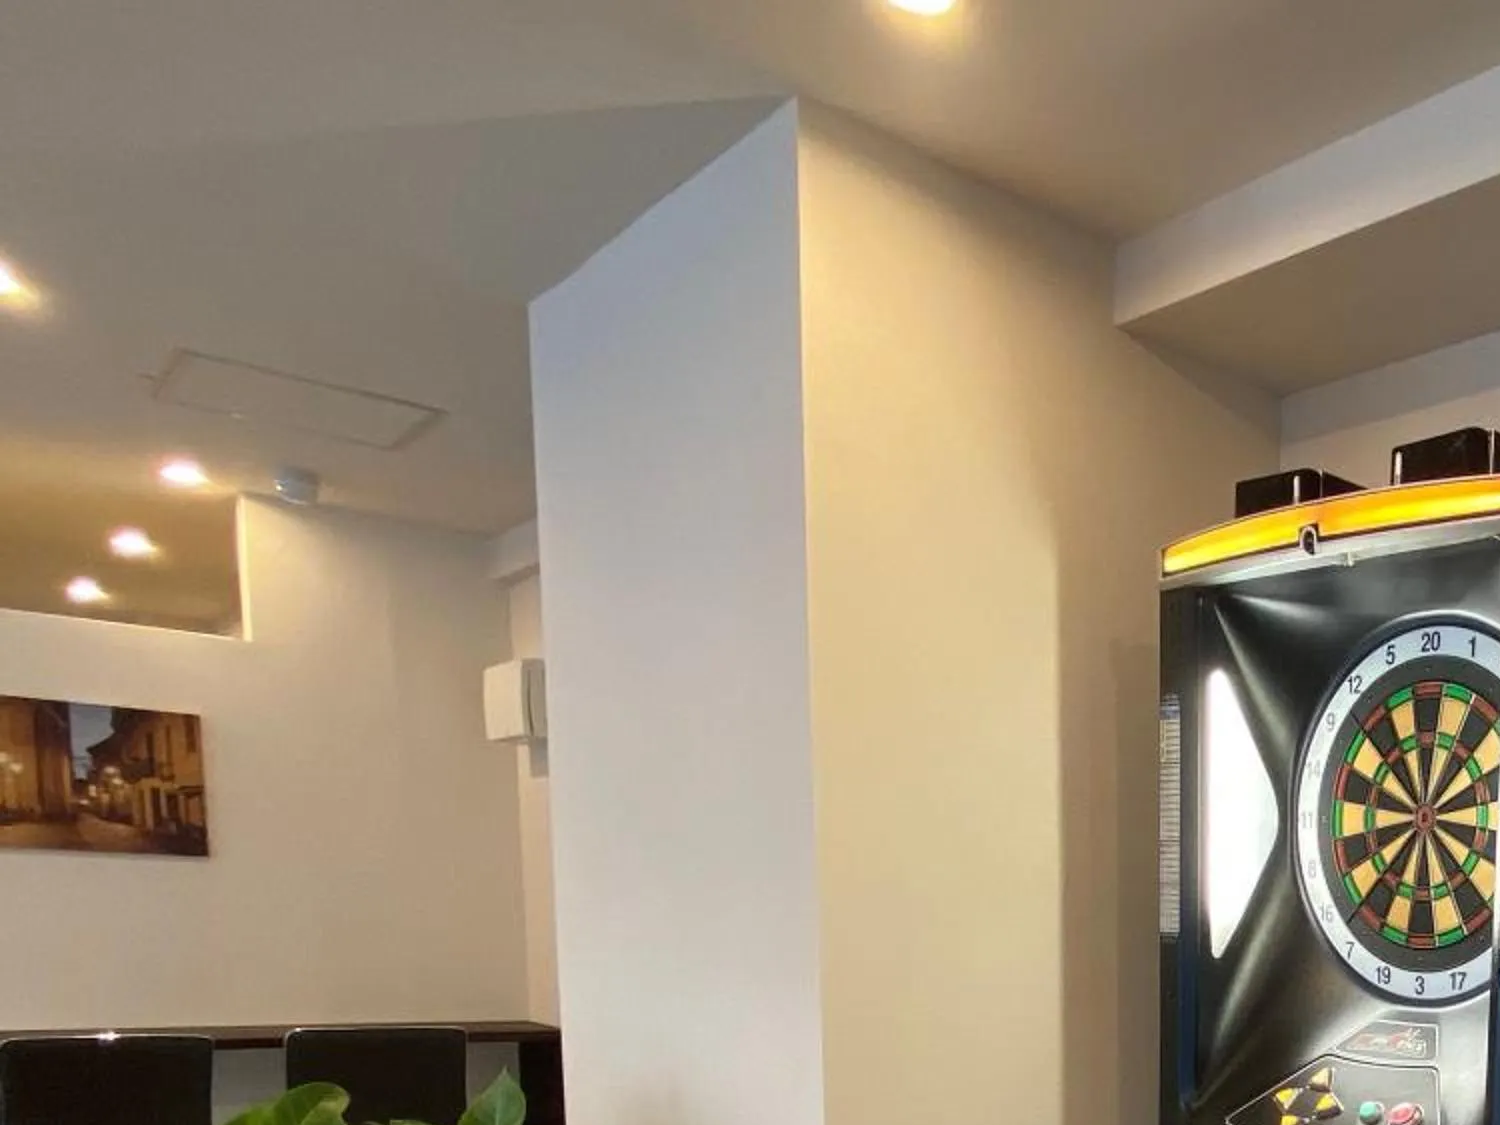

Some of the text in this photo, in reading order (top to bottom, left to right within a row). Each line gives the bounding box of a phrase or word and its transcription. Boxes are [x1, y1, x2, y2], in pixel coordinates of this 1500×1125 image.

[1421, 631, 1441, 653] 20
[1468, 636, 1477, 657] 1
[1385, 644, 1396, 665] 5
[1348, 675, 1363, 694] 12
[1325, 713, 1336, 732] 9
[1345, 941, 1355, 959] 7
[1376, 966, 1391, 985] 19
[1414, 975, 1425, 995] 3
[1449, 972, 1467, 991] 17
